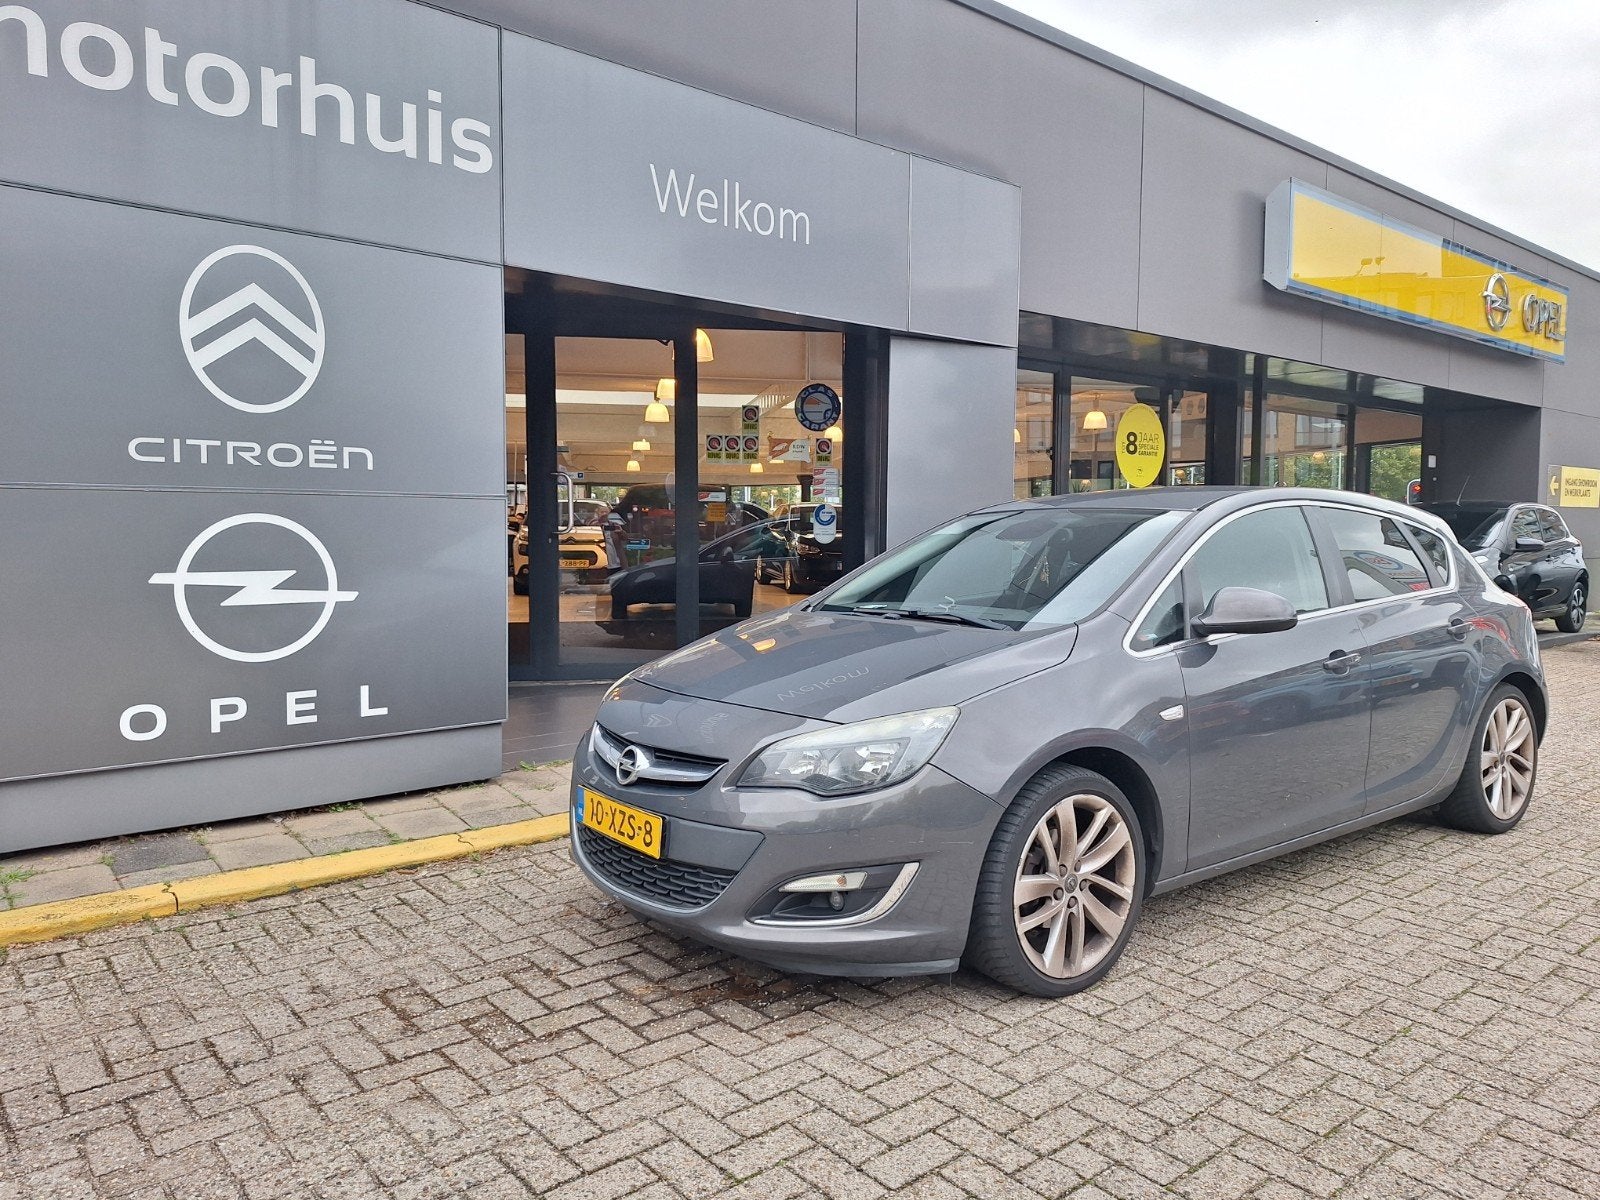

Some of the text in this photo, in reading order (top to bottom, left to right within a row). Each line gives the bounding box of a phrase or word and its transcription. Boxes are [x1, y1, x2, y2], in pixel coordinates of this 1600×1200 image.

[650, 163, 809, 245] Welkom
[1522, 293, 1566, 341] OPEL
[1126, 431, 1159, 455] 8 JAAR
[119, 684, 389, 741] OPEL
[590, 797, 653, 848] 10-XZS-8
